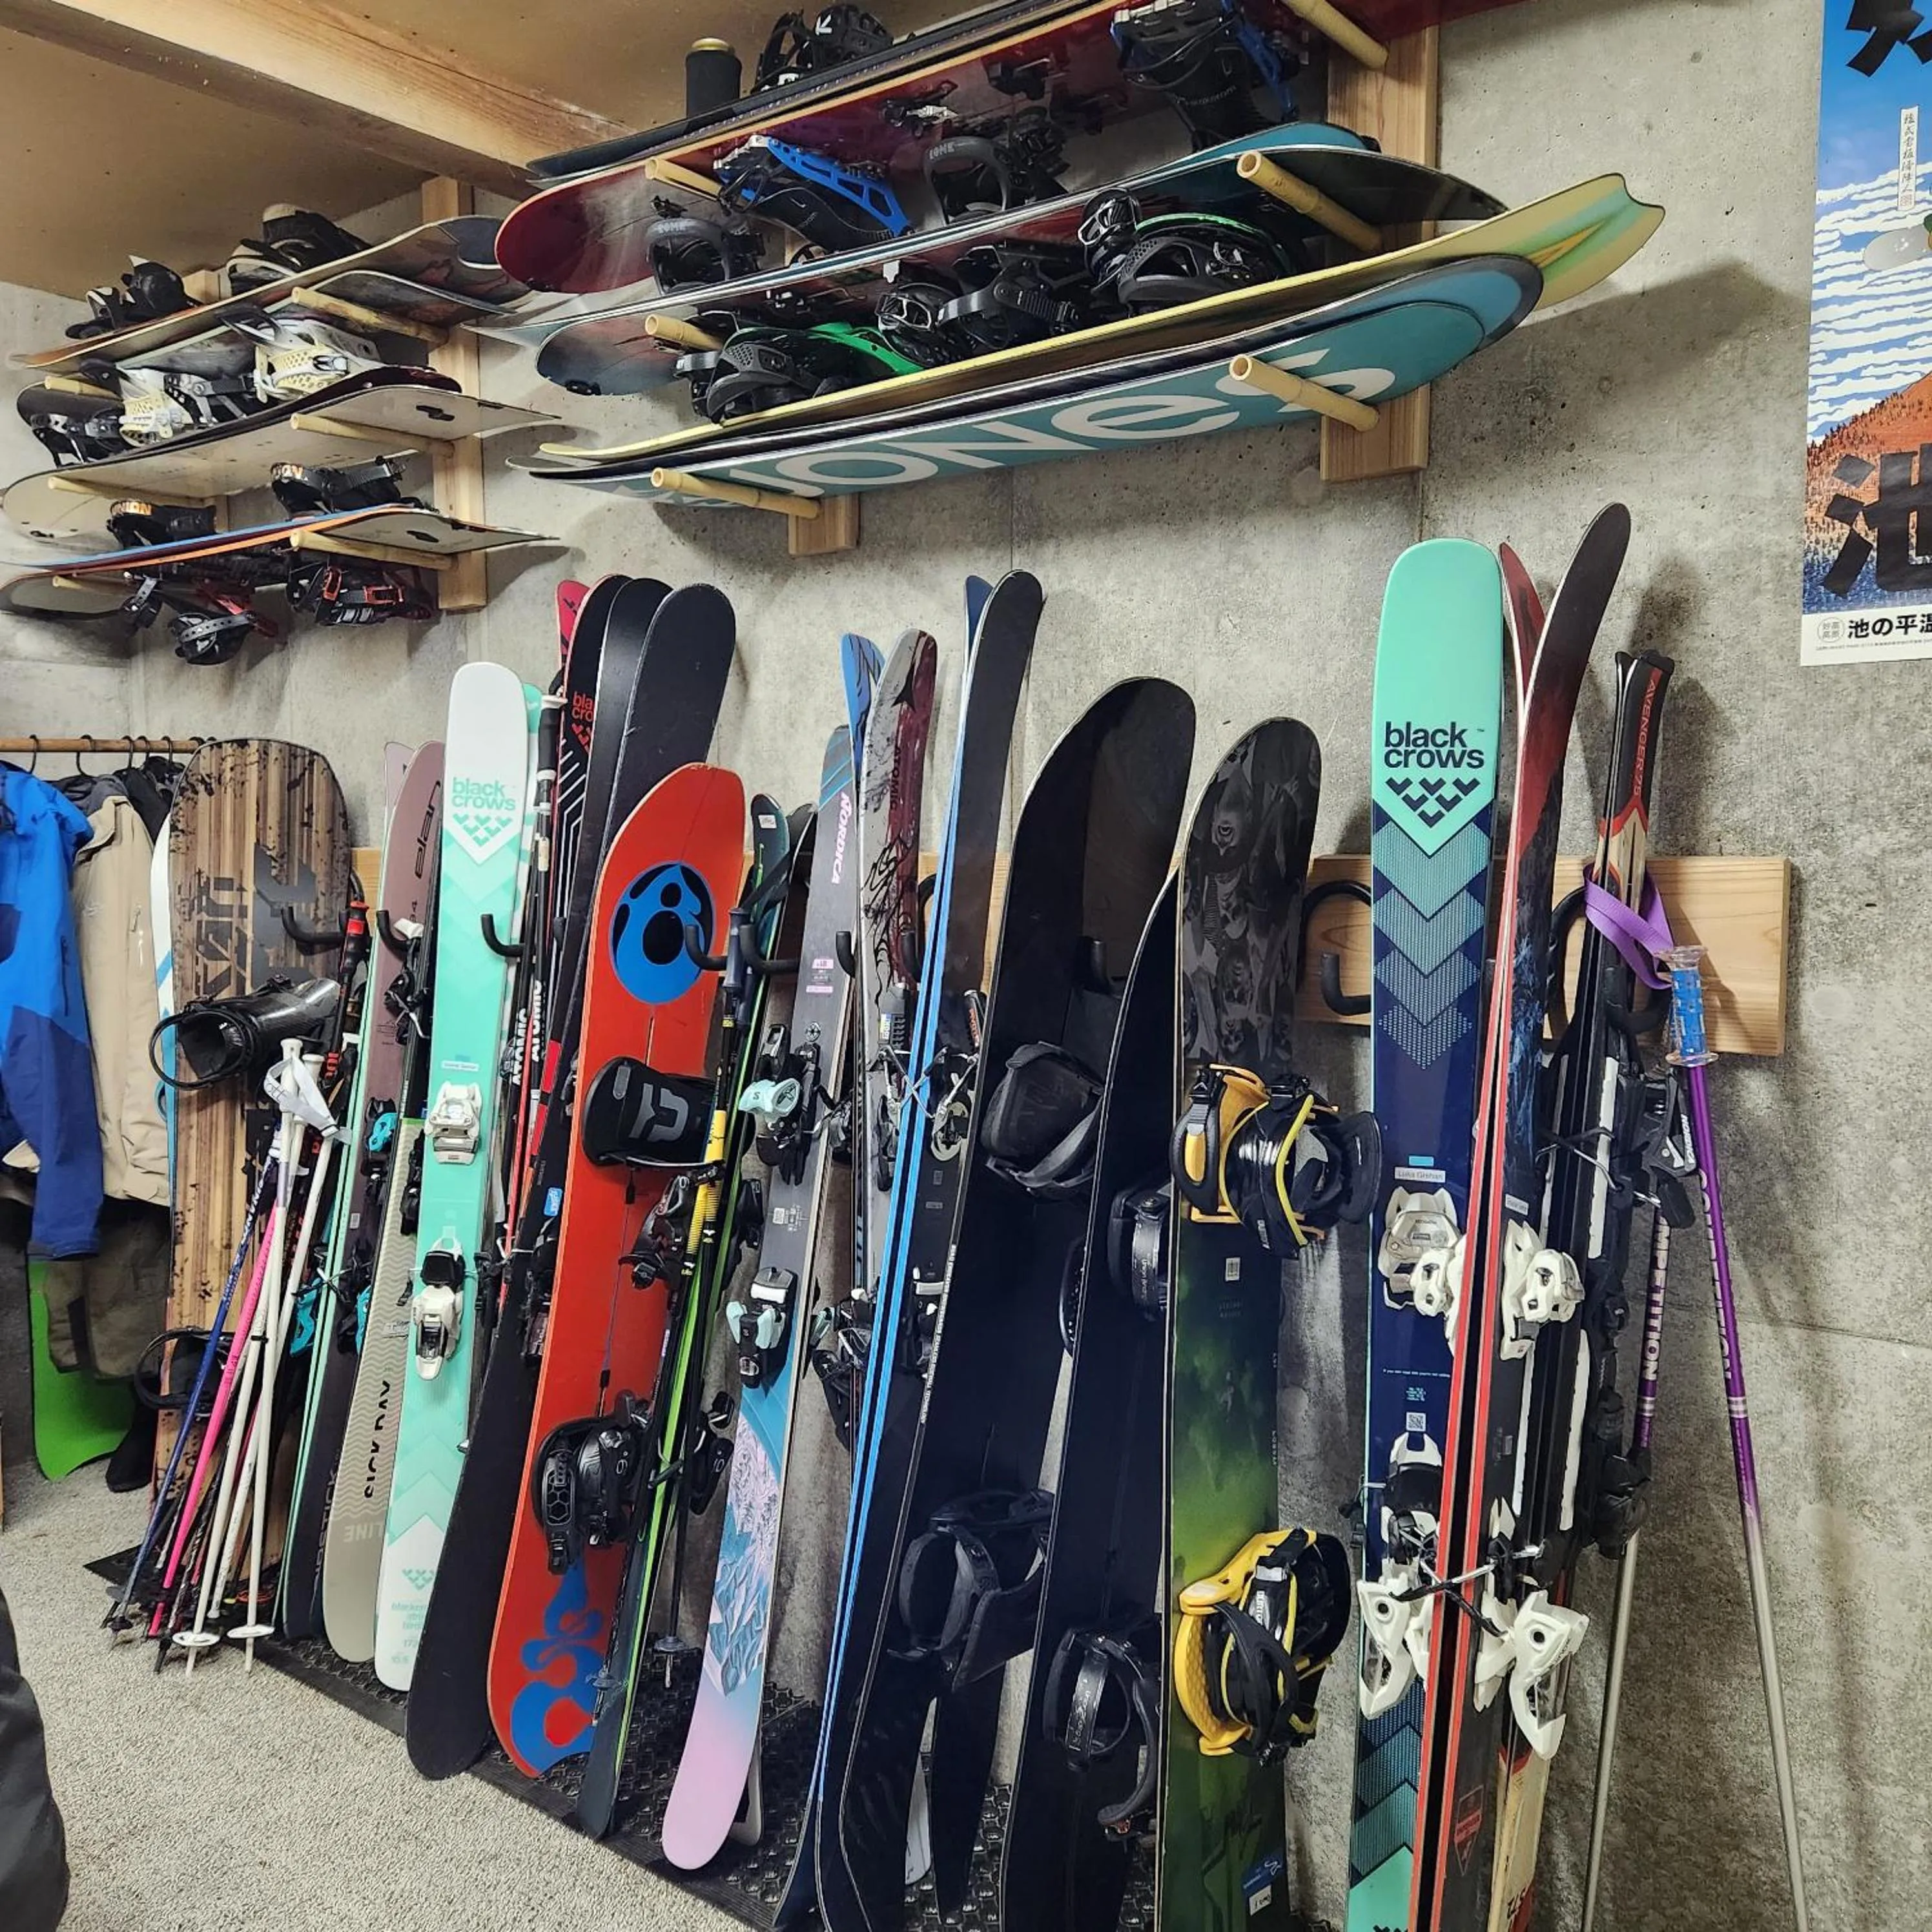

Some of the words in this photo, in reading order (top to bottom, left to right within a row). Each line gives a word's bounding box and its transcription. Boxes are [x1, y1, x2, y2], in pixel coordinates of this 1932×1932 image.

[1384, 721, 1468, 748] black
[1635, 680, 1656, 771] AVENGER
[890, 745, 901, 809] ATOMIC
[1384, 748, 1485, 769] crows
[452, 777, 505, 797] black
[452, 794, 516, 811] crows
[415, 780, 441, 879] elan
[831, 791, 852, 885] NORDICA
[1680, 1113, 1695, 1164] NORDICA
[344, 1521, 384, 1543] LINE
